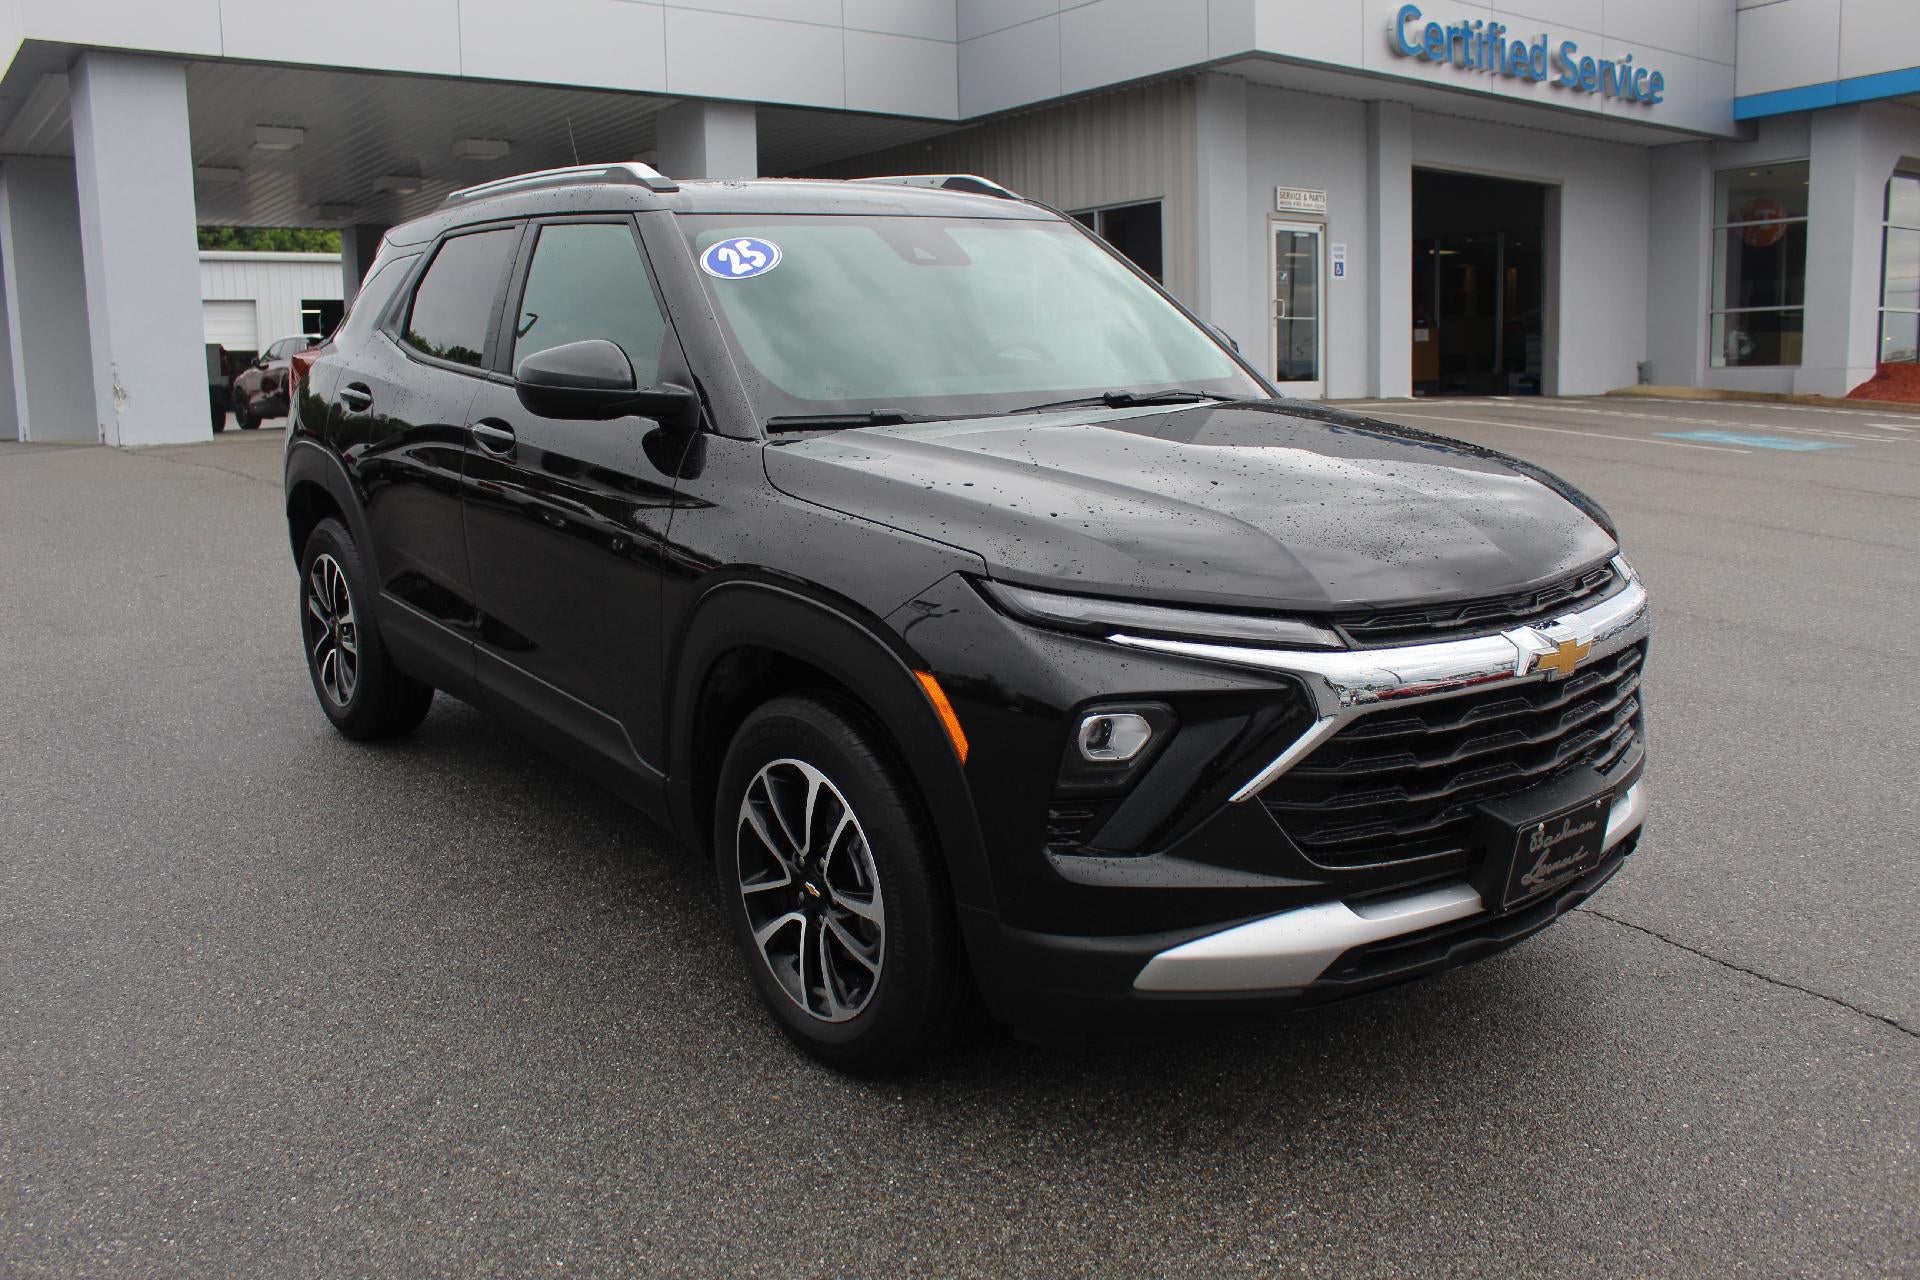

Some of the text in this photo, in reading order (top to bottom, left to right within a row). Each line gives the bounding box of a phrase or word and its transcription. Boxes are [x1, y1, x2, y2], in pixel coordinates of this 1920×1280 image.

[1395, 3, 1665, 104] Certified Service
[1280, 191, 1302, 201] SERVICE
[1308, 194, 1325, 203] PARTS
[718, 240, 767, 275] 25
